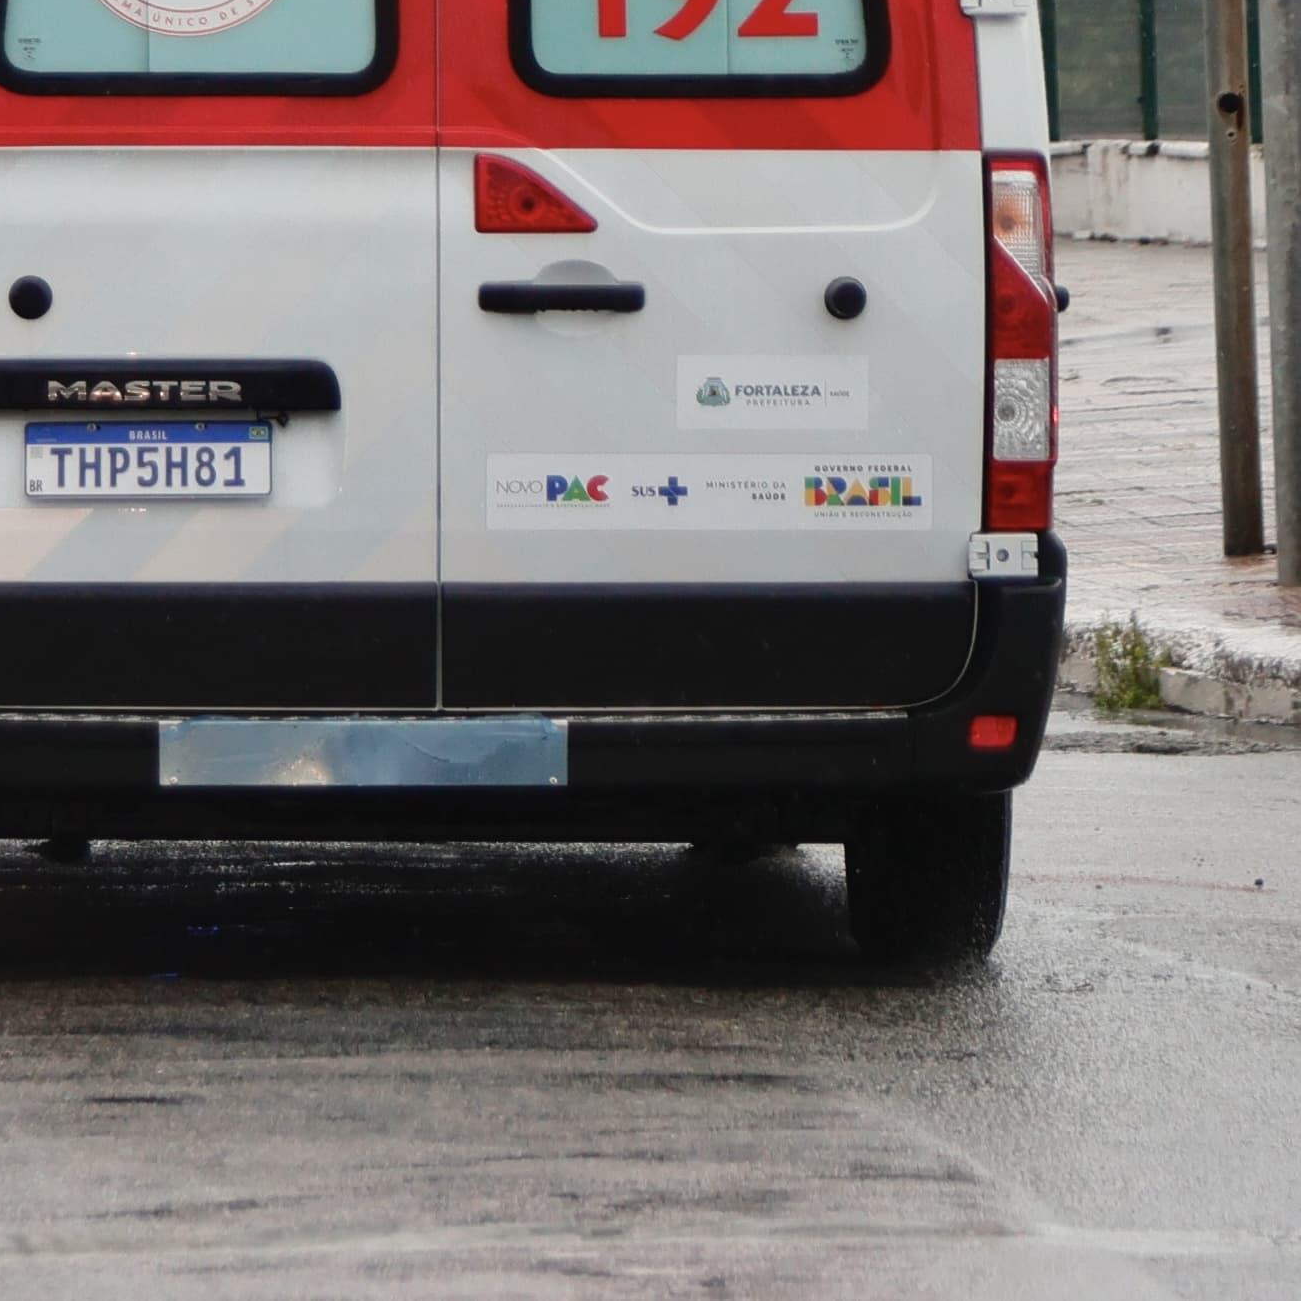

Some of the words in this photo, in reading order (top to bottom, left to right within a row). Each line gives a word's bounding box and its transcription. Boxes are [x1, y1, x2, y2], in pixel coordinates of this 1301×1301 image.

[152, 10, 209, 27] ÚNICO
[218, 7, 239, 22] DE
[48, 380, 243, 401] MASTER
[734, 384, 823, 398] FORTALEZA
[746, 398, 811, 407] PREFEITURA
[128, 430, 168, 441] BRASIL
[50, 446, 246, 489] THP5H81
[814, 464, 864, 473] GOVERNO
[867, 464, 913, 473] FEDERAL
[29, 479, 43, 493] BR
[496, 479, 544, 495] NOVO
[546, 474, 610, 502] PAC
[705, 479, 769, 490] MINISTÉRIO
[772, 480, 787, 490] DA
[804, 475, 923, 507] BRASIL
[631, 485, 656, 498] SUS
[751, 490, 787, 501] SAÚDE
[813, 510, 841, 519] UNIÃO
[842, 511, 847, 519] E
